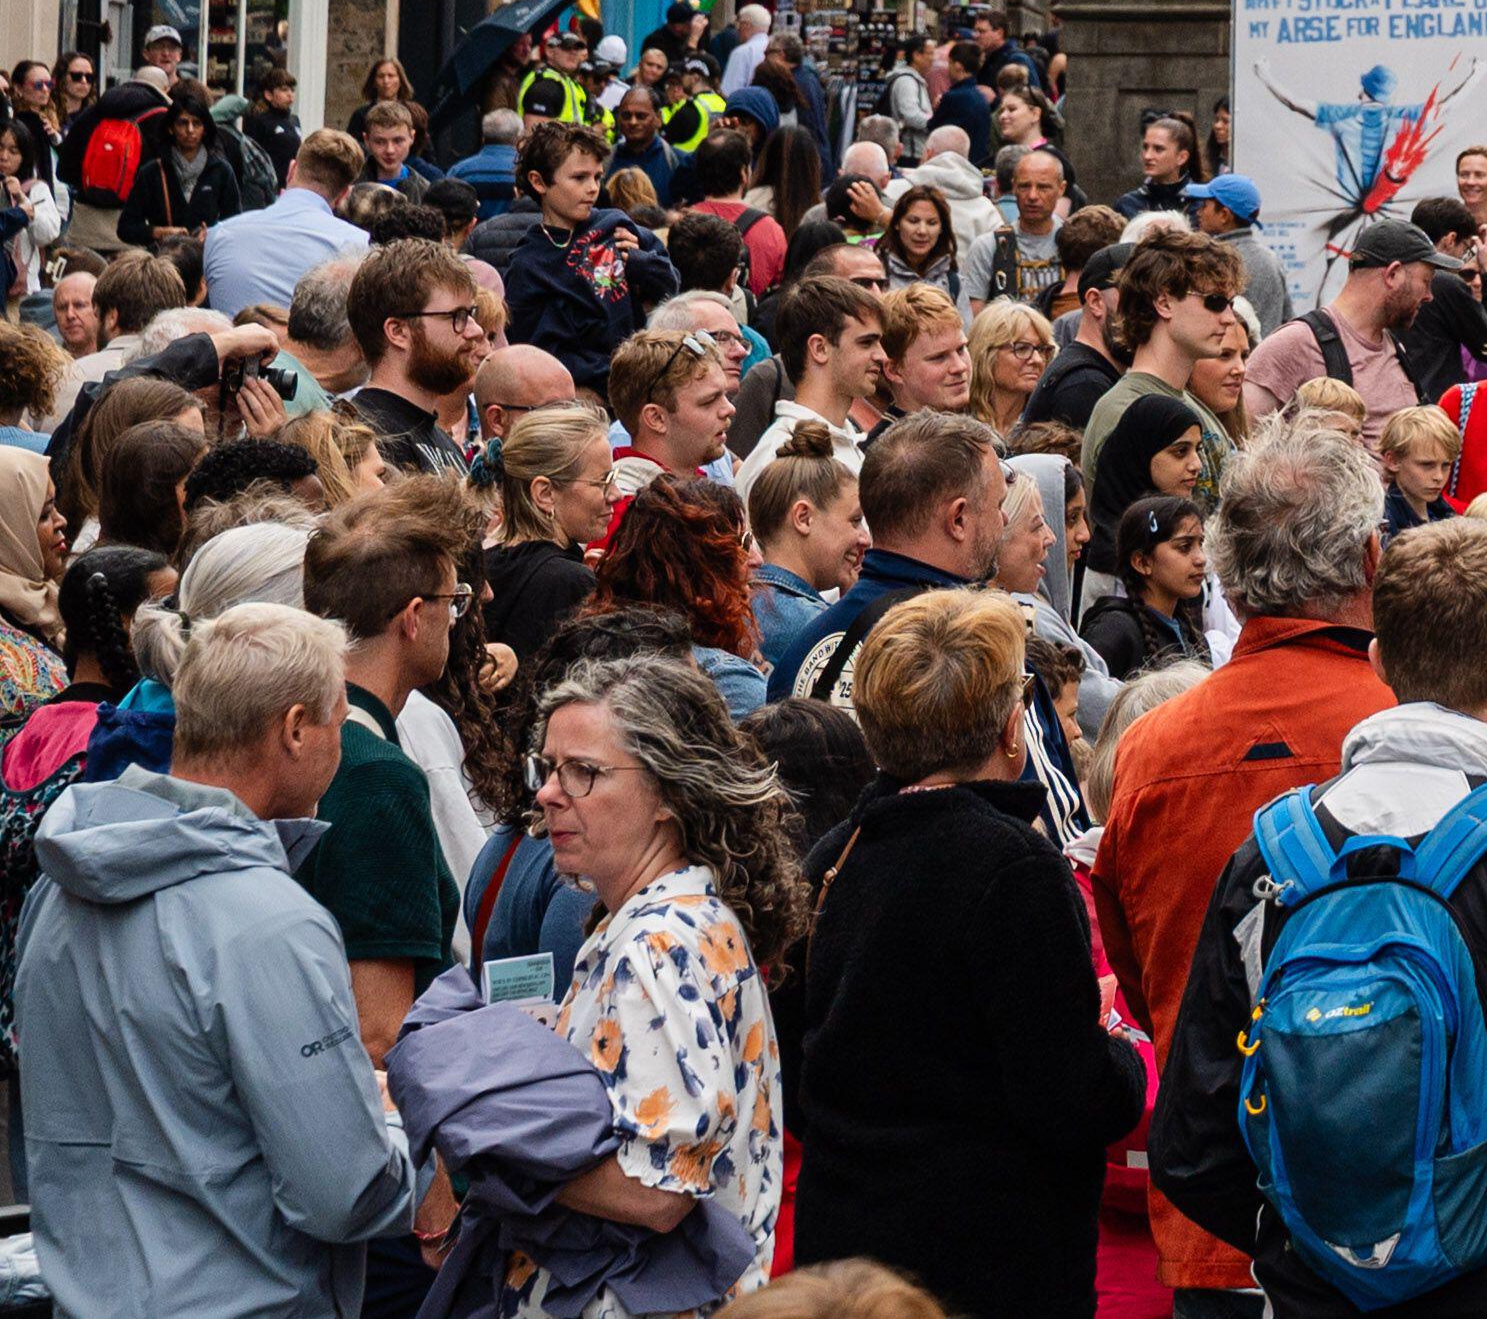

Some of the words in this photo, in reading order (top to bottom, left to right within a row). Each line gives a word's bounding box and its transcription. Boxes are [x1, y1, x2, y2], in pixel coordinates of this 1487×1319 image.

[1249, 22, 1269, 38] MY
[1277, 15, 1342, 44] ARSE
[1347, 17, 1379, 38] FOR
[301, 1041, 325, 1058] OR
